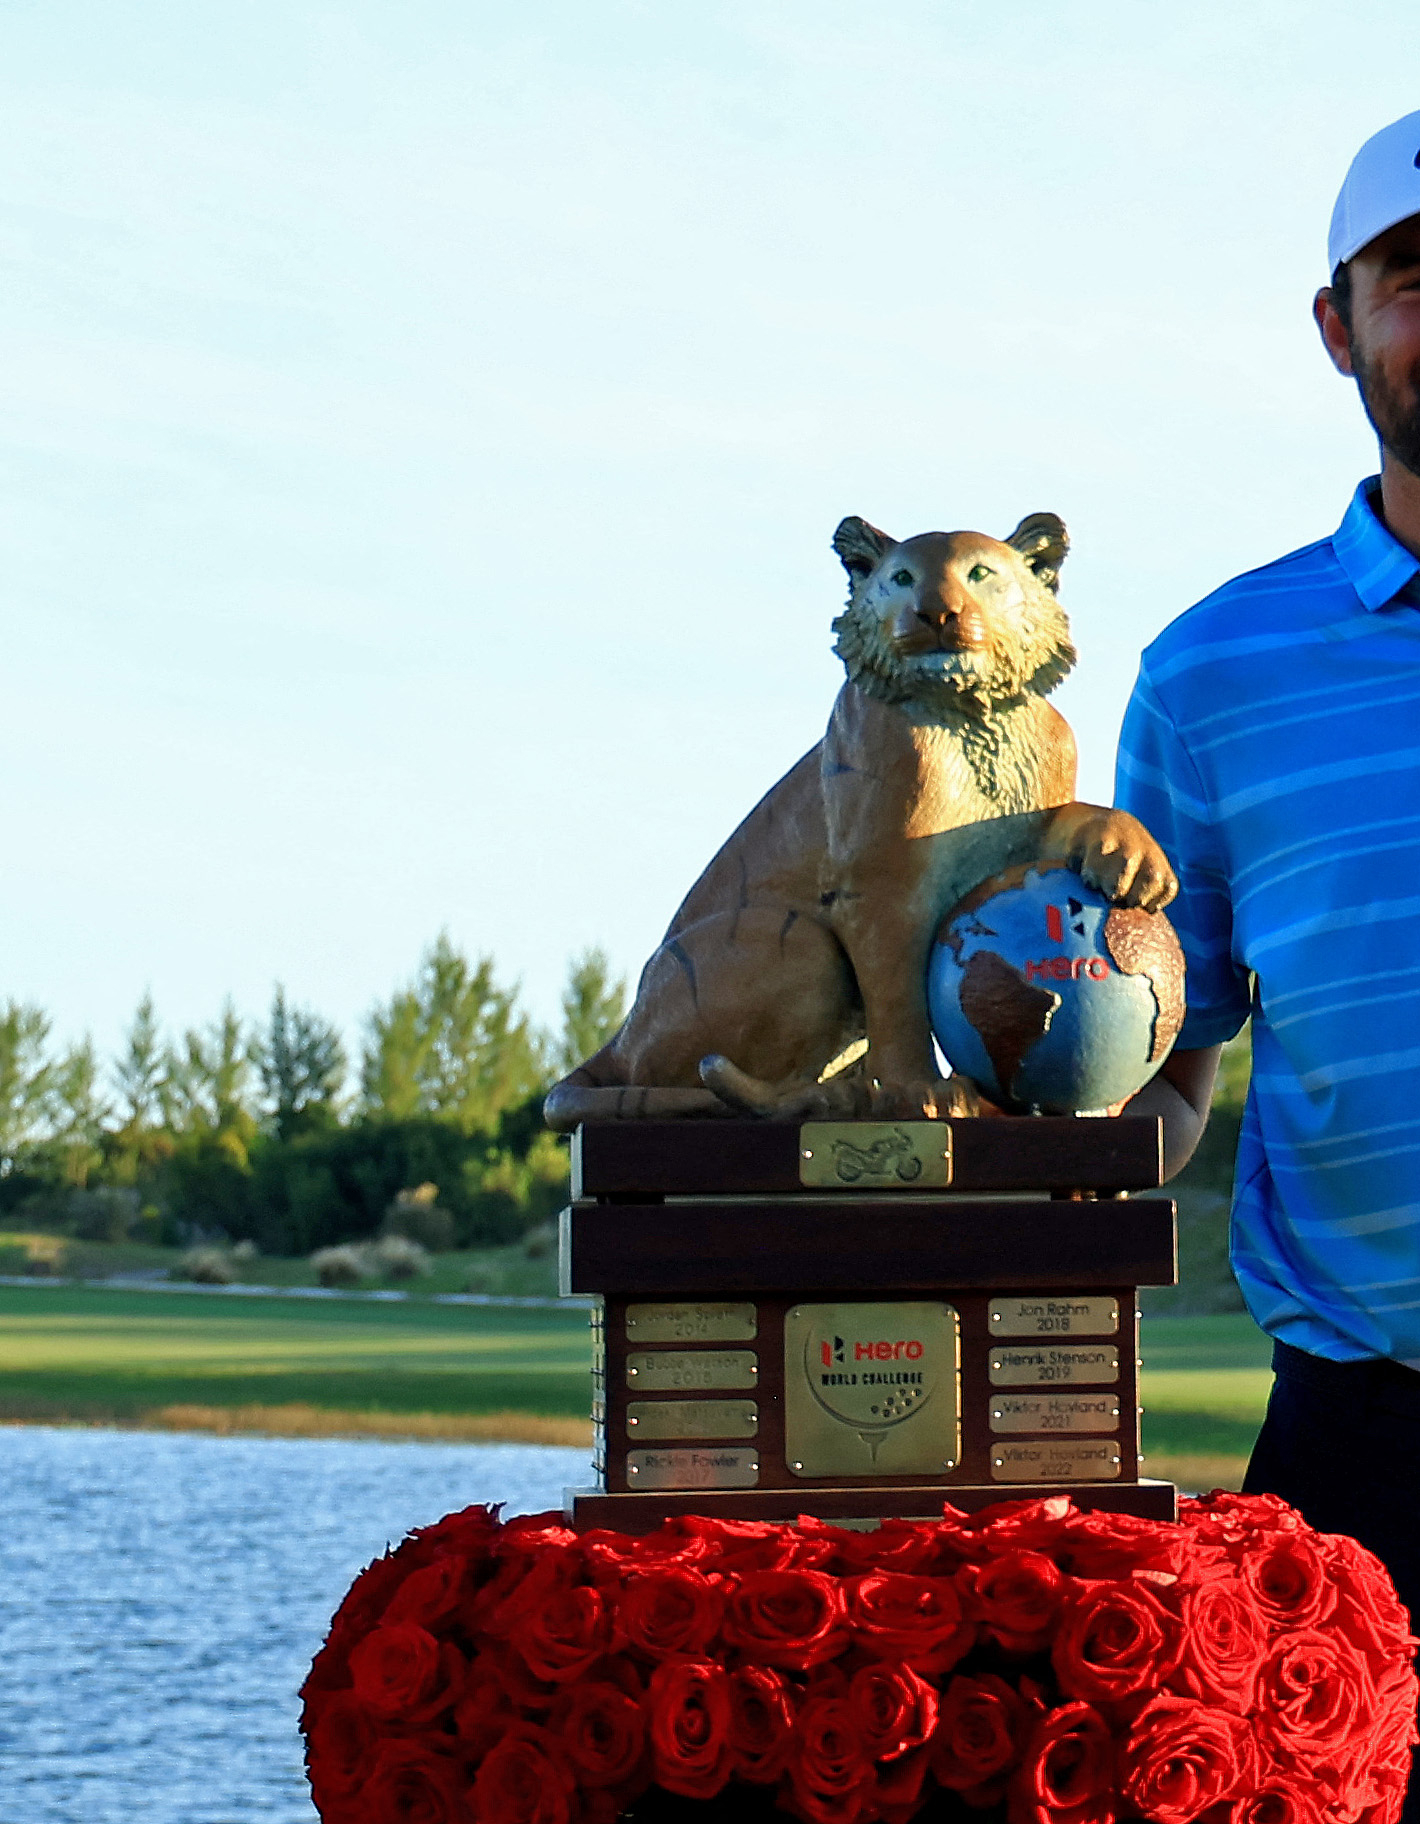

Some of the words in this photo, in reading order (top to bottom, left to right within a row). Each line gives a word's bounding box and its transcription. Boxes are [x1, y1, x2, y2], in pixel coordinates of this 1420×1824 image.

[1025, 957, 1110, 981] Hero
[1018, 1304, 1043, 1317] Jon
[1047, 1303, 1090, 1316] Rahm
[1036, 1317, 1070, 1331] 2018
[853, 1340, 924, 1361] Hero
[1048, 1350, 1105, 1364] Stenson
[821, 1373, 857, 1386] WORLD
[862, 1372, 923, 1385] CHALLENGE
[1037, 1366, 1071, 1380] 2019
